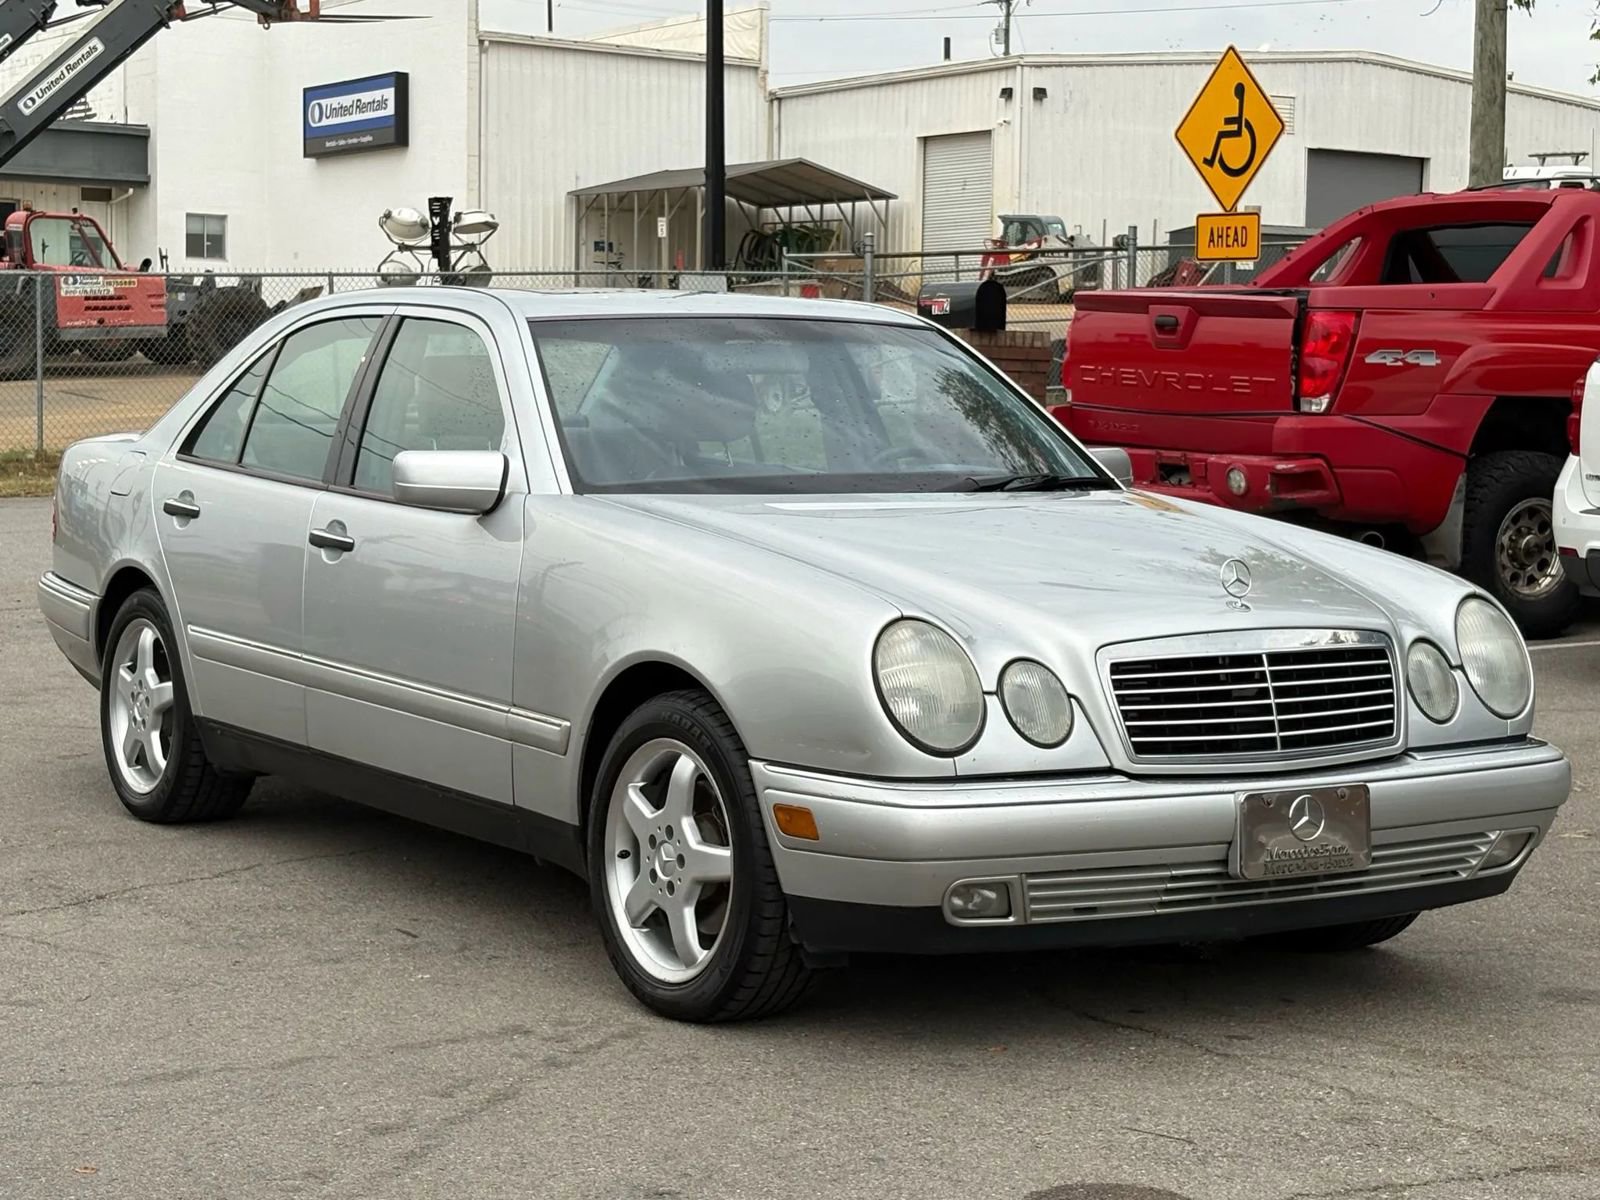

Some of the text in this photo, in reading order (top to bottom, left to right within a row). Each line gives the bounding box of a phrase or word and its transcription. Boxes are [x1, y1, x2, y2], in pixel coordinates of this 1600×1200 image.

[35, 44, 99, 100] United Rentals
[324, 94, 389, 120] United Rentals
[1207, 225, 1248, 249] AHEAD
[1079, 364, 1277, 395] CHEVROLET
